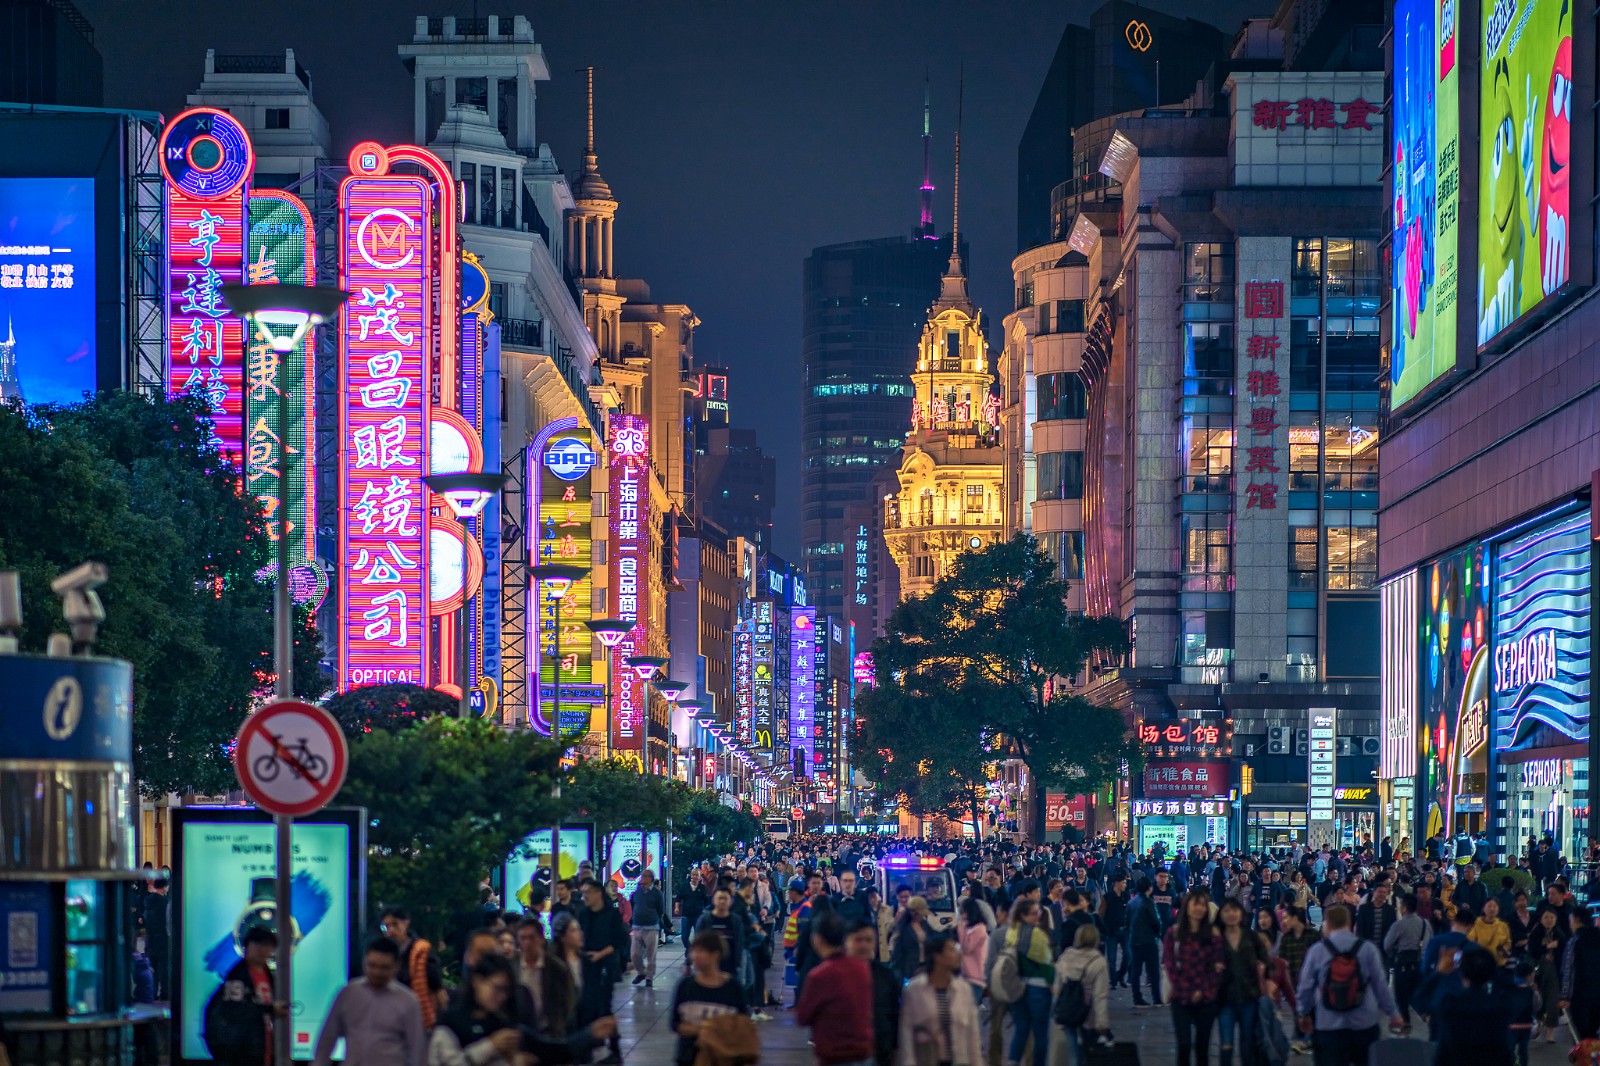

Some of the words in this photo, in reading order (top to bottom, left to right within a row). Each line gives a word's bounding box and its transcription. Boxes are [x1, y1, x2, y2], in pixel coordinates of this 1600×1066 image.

[1253, 98, 1381, 131] 新雅食
[27, 264, 48, 276] 自由
[1245, 334, 1281, 510] 新雅粤菜馆
[545, 453, 596, 464] BAC
[559, 485, 582, 677] 原上海子公司
[856, 525, 868, 605] 上海置地广场
[483, 588, 498, 679] Pharmacy
[352, 668, 417, 684] OPTICAL
[1495, 629, 1556, 692] SEPHORA
[620, 673, 634, 737] Foodhall
[1524, 760, 1561, 788] SEPHORA
[232, 843, 301, 855] NUMBS
